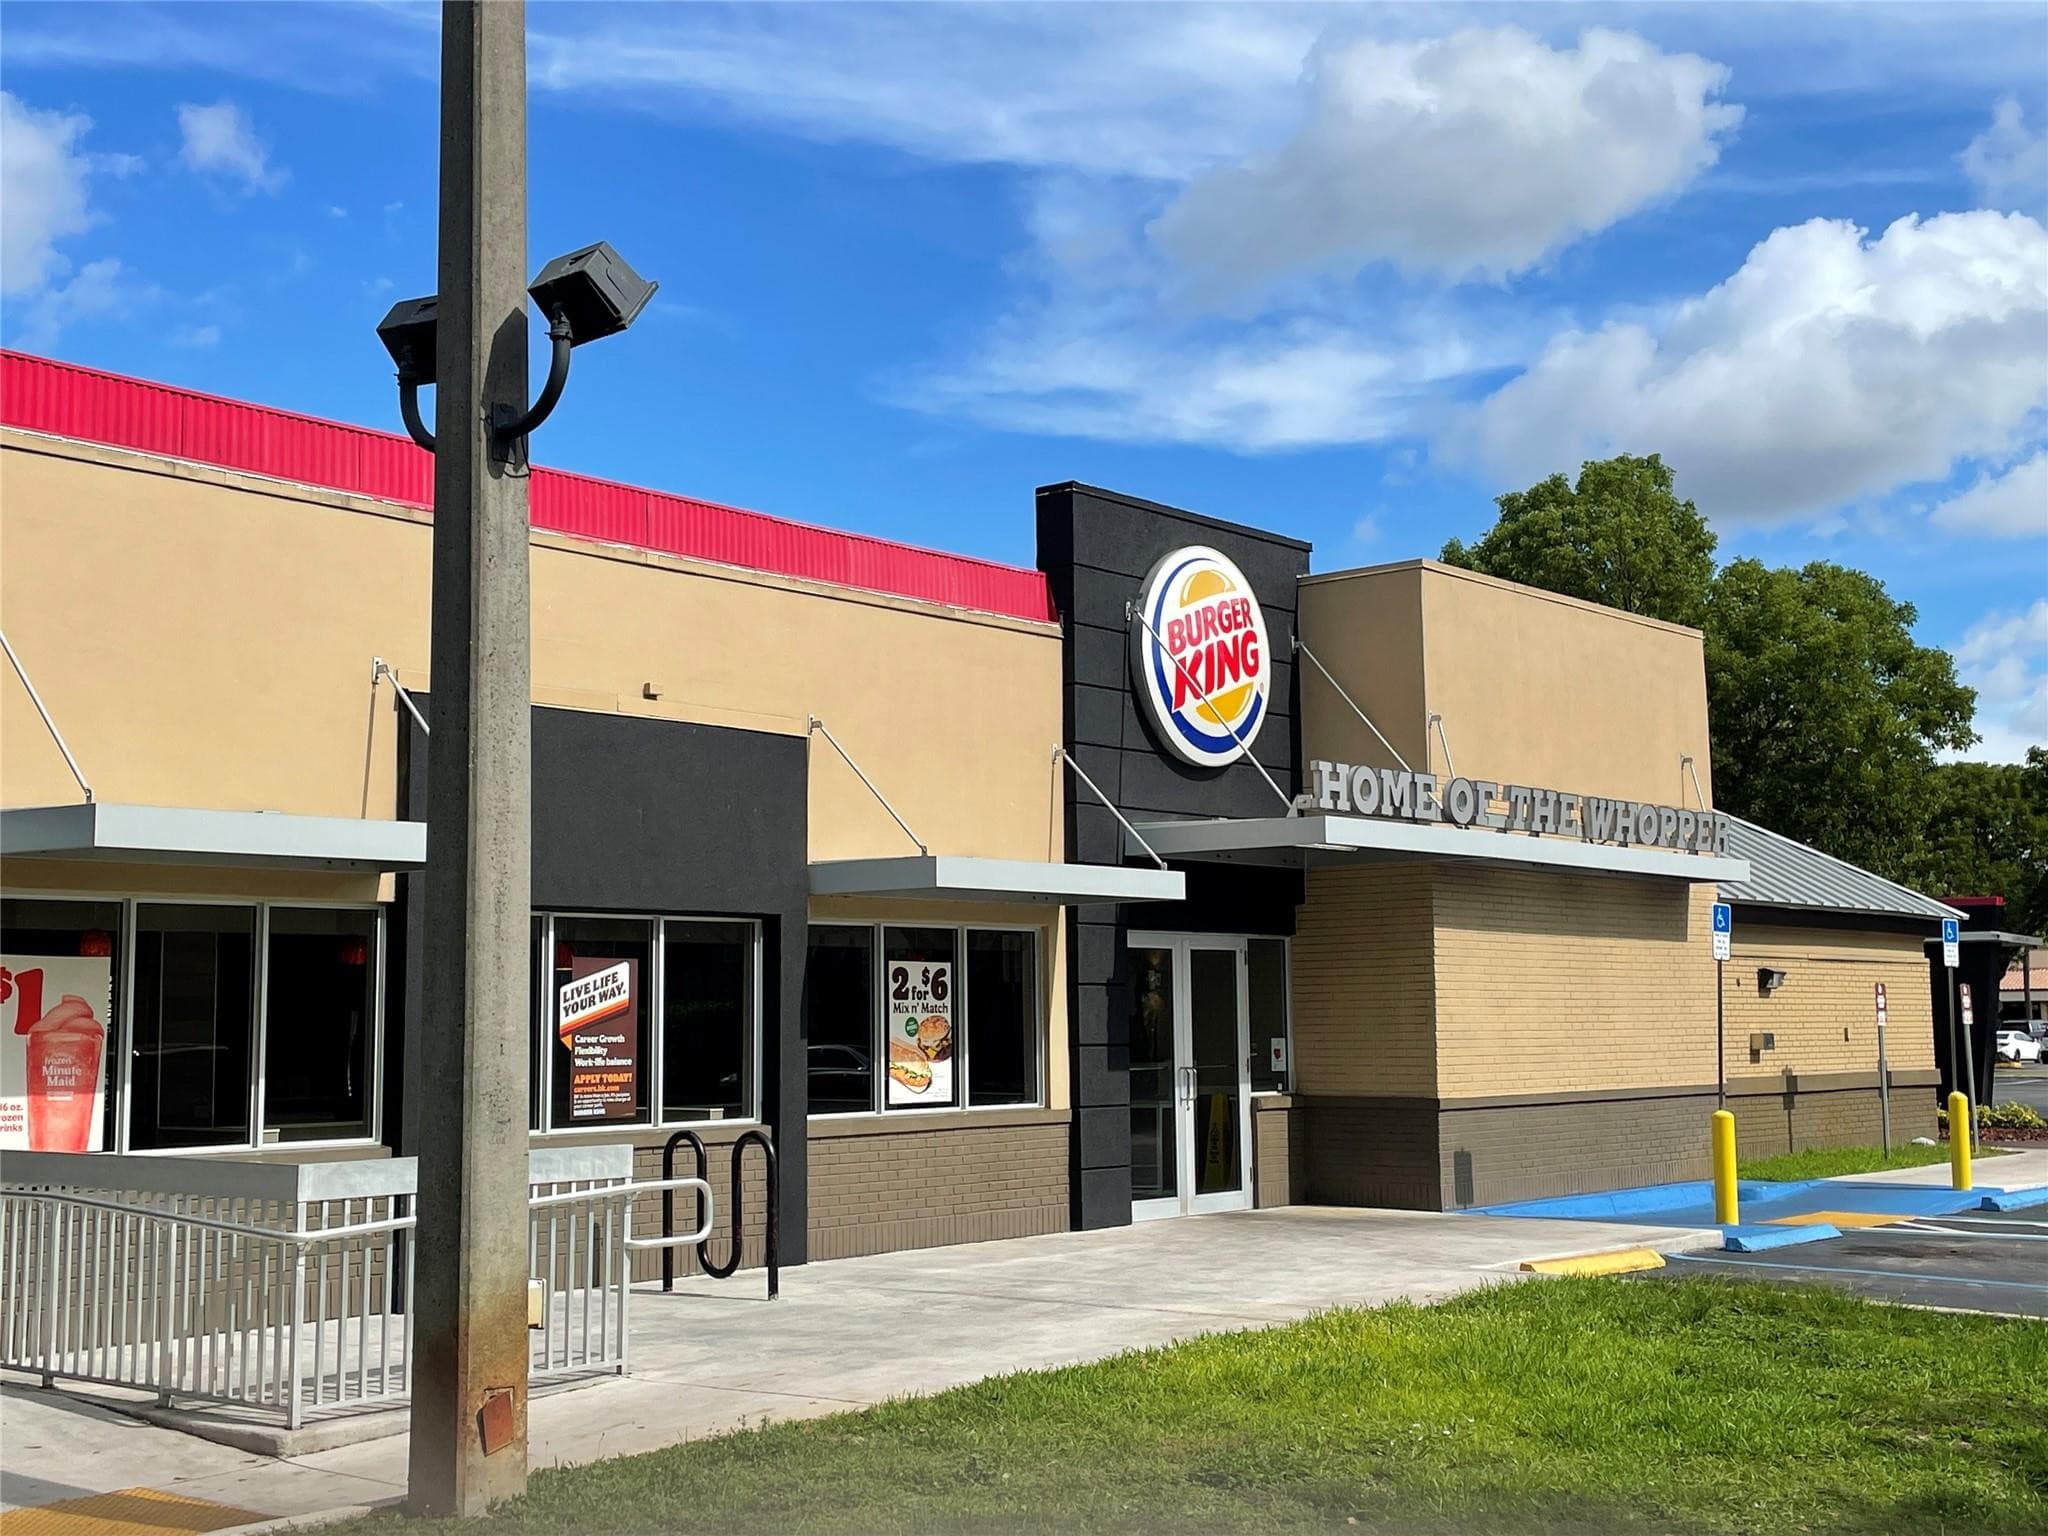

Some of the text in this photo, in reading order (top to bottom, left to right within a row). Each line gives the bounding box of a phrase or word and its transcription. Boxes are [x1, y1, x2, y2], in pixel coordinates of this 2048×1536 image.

[1167, 597, 1254, 656] BURGER
[1172, 630, 1260, 710] KING
[1311, 760, 1731, 853] HOME OF THE WHOPPER
[563, 971, 619, 1003] LIVE LIFE
[892, 966, 949, 1002] 2 for $6
[562, 981, 626, 1017] YOUR WAY.
[893, 1002, 910, 1014] Mix
[921, 1002, 949, 1014] Match
[574, 1034, 626, 1044] Career Growth
[574, 1046, 608, 1056] Flexibility
[574, 1057, 633, 1067] Work-life balance
[42, 1065, 82, 1077] Minute
[47, 1075, 76, 1087] Maid
[573, 1072, 633, 1084] APPLY TODAY!
[0, 1124, 23, 1132] rinks
